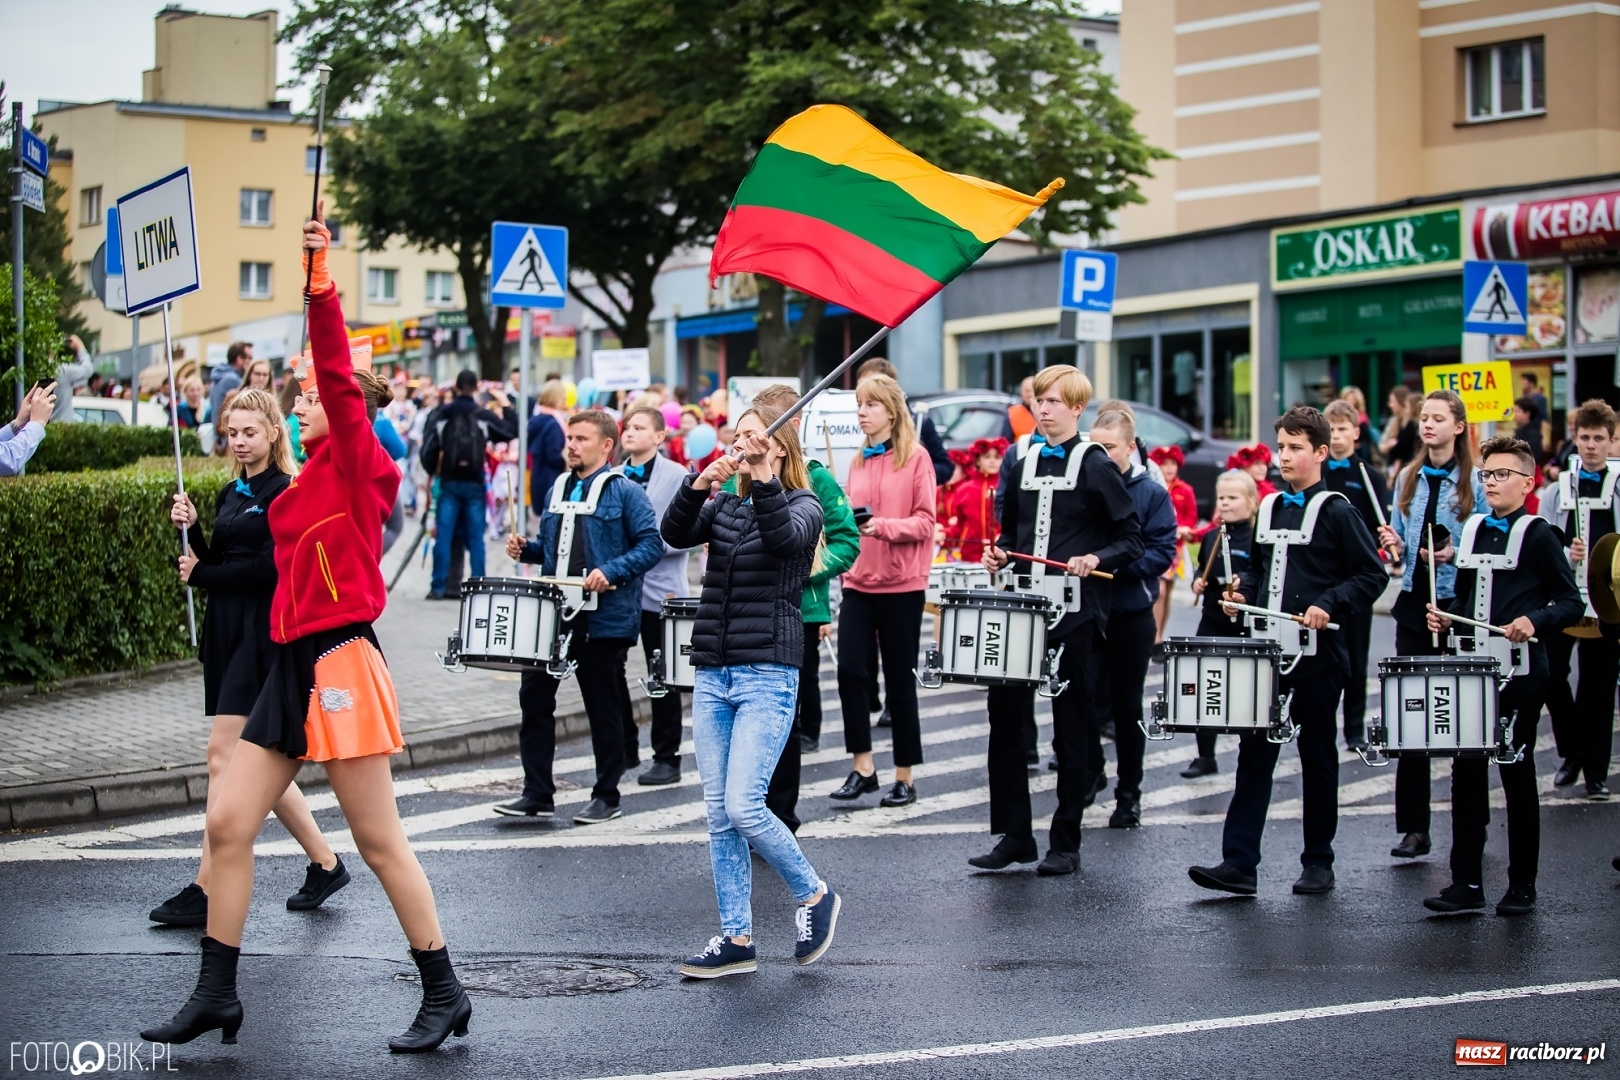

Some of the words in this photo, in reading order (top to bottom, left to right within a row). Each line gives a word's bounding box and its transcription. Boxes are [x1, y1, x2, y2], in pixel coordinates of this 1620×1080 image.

[135, 216, 179, 271] LITWA
[1313, 221, 1418, 270] OSKAR
[1073, 256, 1106, 303] P
[1436, 370, 1497, 395] TĘCZA
[493, 605, 509, 646] FAME
[983, 622, 1001, 667] FAME
[1206, 669, 1222, 716] FAME
[1434, 686, 1450, 735] FAME
